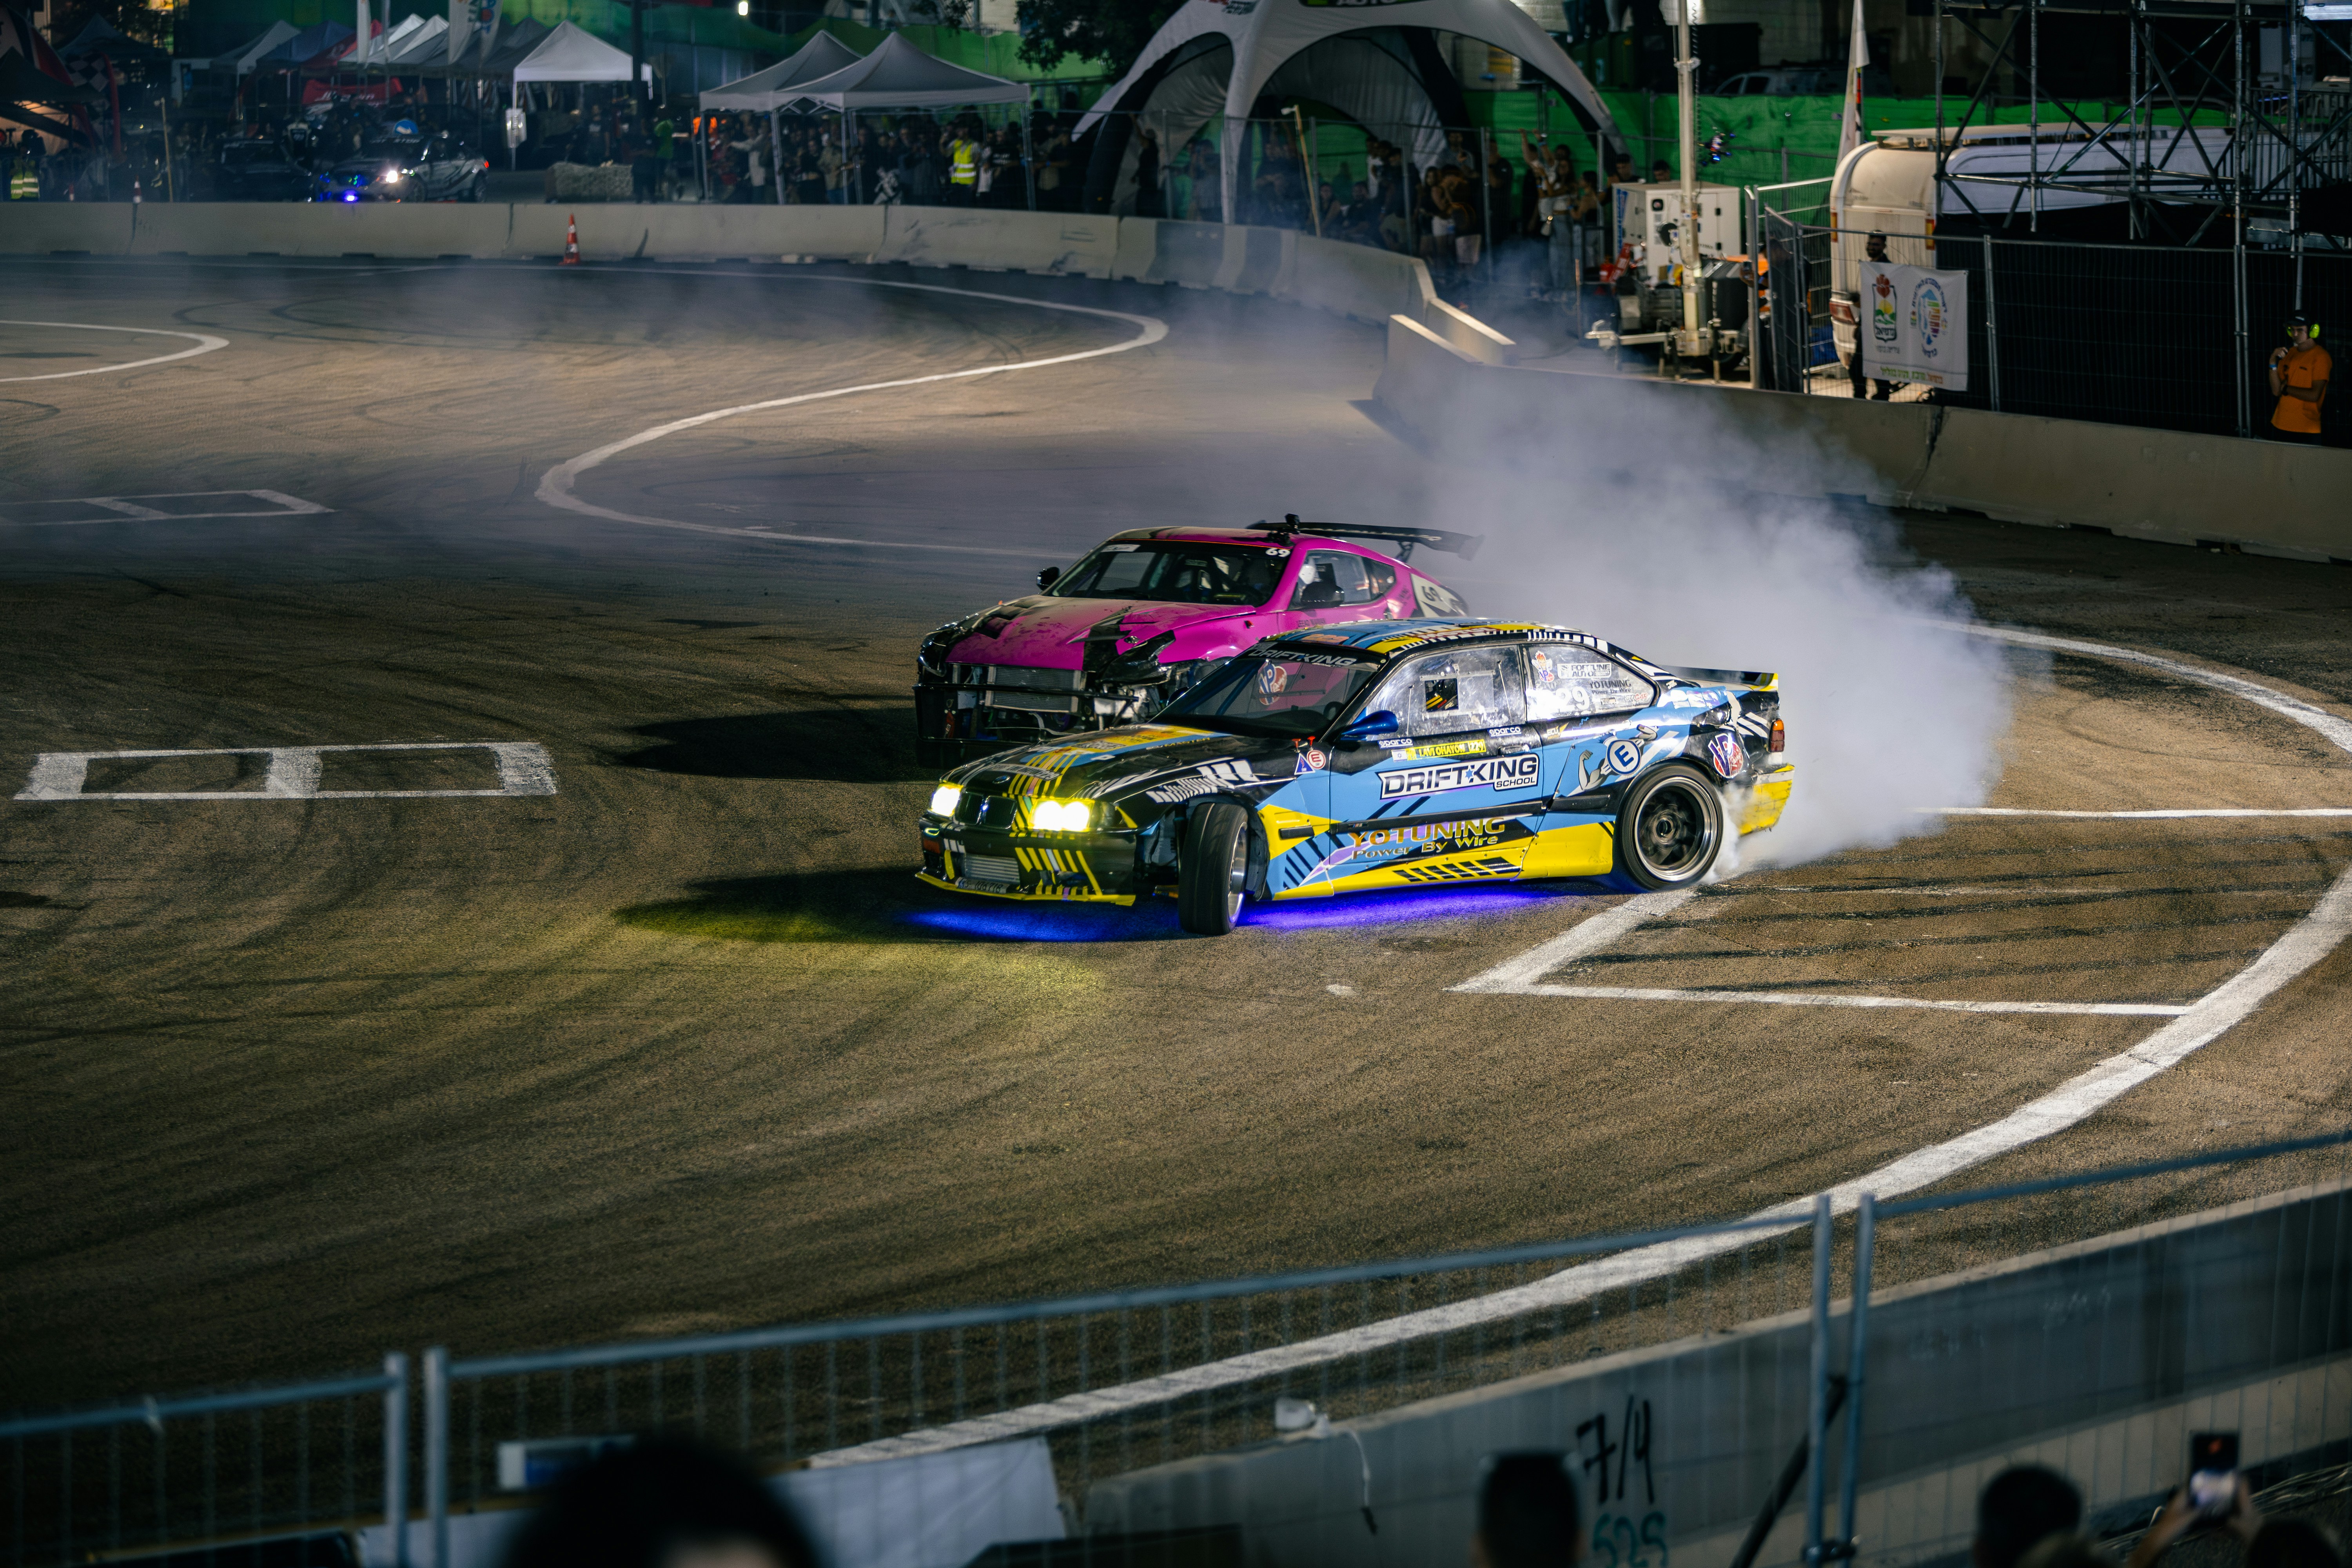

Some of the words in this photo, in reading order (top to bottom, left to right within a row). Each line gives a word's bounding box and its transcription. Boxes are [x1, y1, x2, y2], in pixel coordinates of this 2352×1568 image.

[1266, 548, 1290, 557] 69
[1422, 586, 1441, 602] 69
[1589, 680, 1631, 689] YOTUNING
[1489, 727, 1521, 736] sparco
[1547, 727, 1559, 735] ECU
[1379, 739, 1412, 748] sparco
[1419, 747, 1436, 757] LAVI
[1436, 743, 1466, 755] OHAYON
[1470, 741, 1484, 751] 229
[1311, 754, 1321, 762] E
[1615, 745, 1634, 767] E
[1709, 734, 1734, 777] VP
[1384, 757, 1537, 795] DRIFTKING
[1497, 777, 1535, 788] SCHOOL
[1348, 818, 1505, 848] YOTUNING
[1351, 846, 1413, 860] Power
[1421, 841, 1448, 853] By
[1455, 836, 1498, 848] Wire
